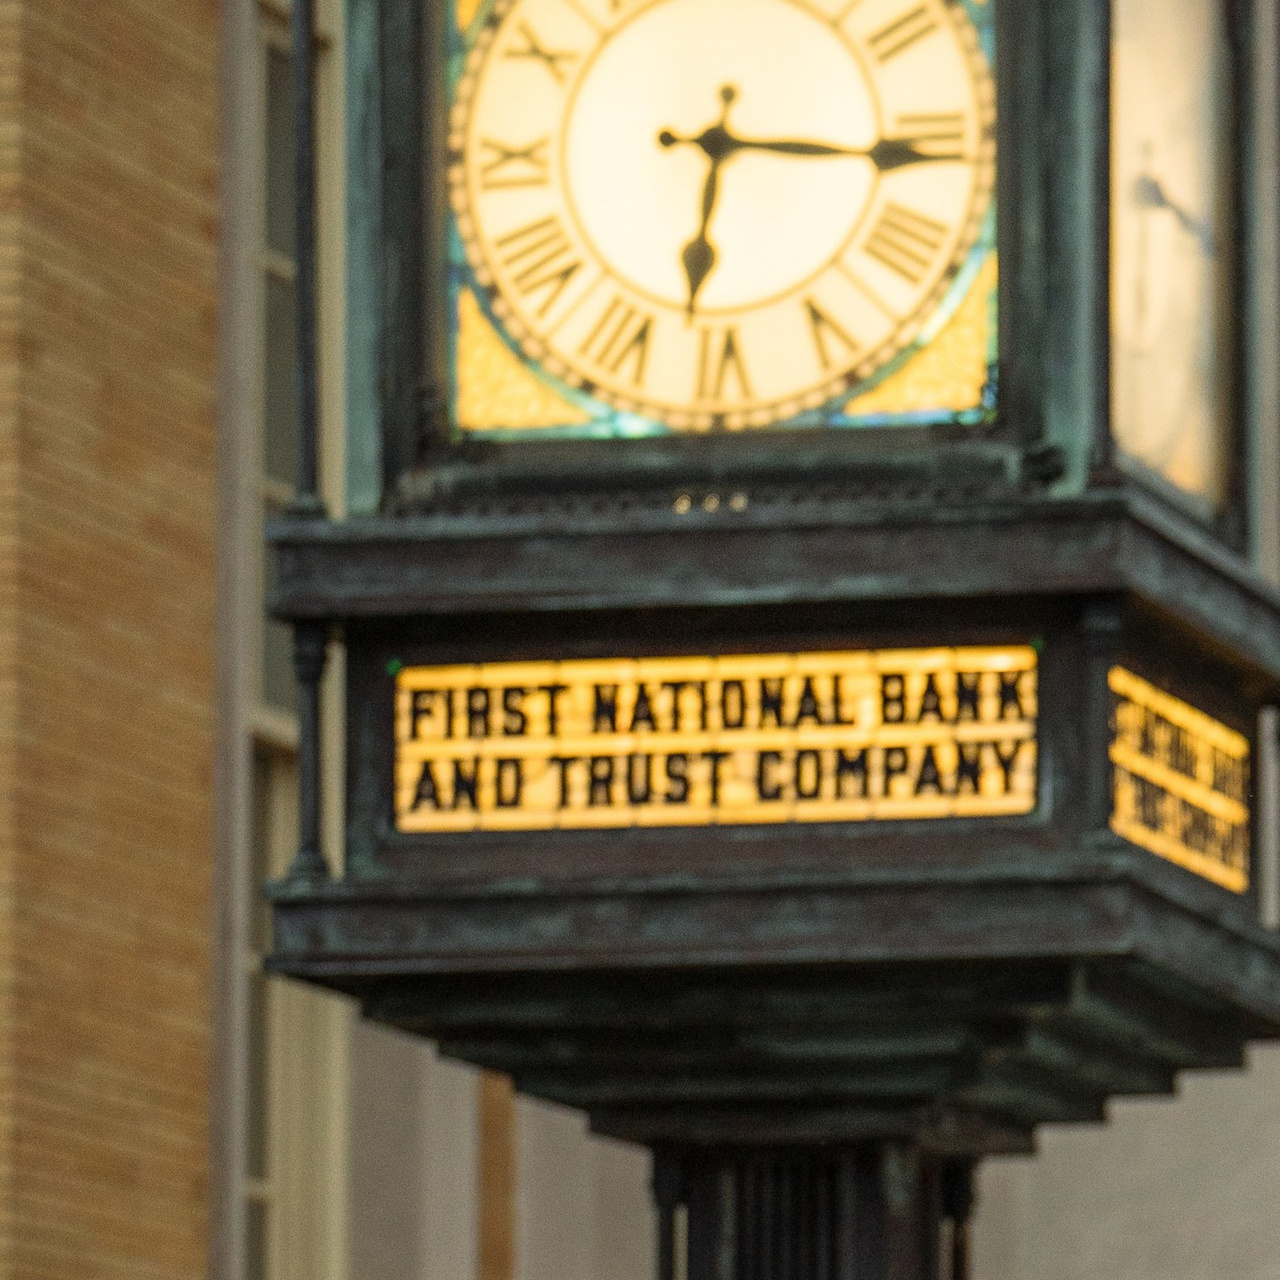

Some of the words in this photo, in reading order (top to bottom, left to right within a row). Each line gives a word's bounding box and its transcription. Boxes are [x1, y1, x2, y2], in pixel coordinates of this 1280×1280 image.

[409, 684, 569, 738] FIRST
[593, 673, 854, 731] NATIONAL
[882, 670, 1034, 724] BANK
[409, 755, 520, 812] AND
[547, 748, 730, 808] TRUST
[757, 740, 1026, 801] COMPANY
